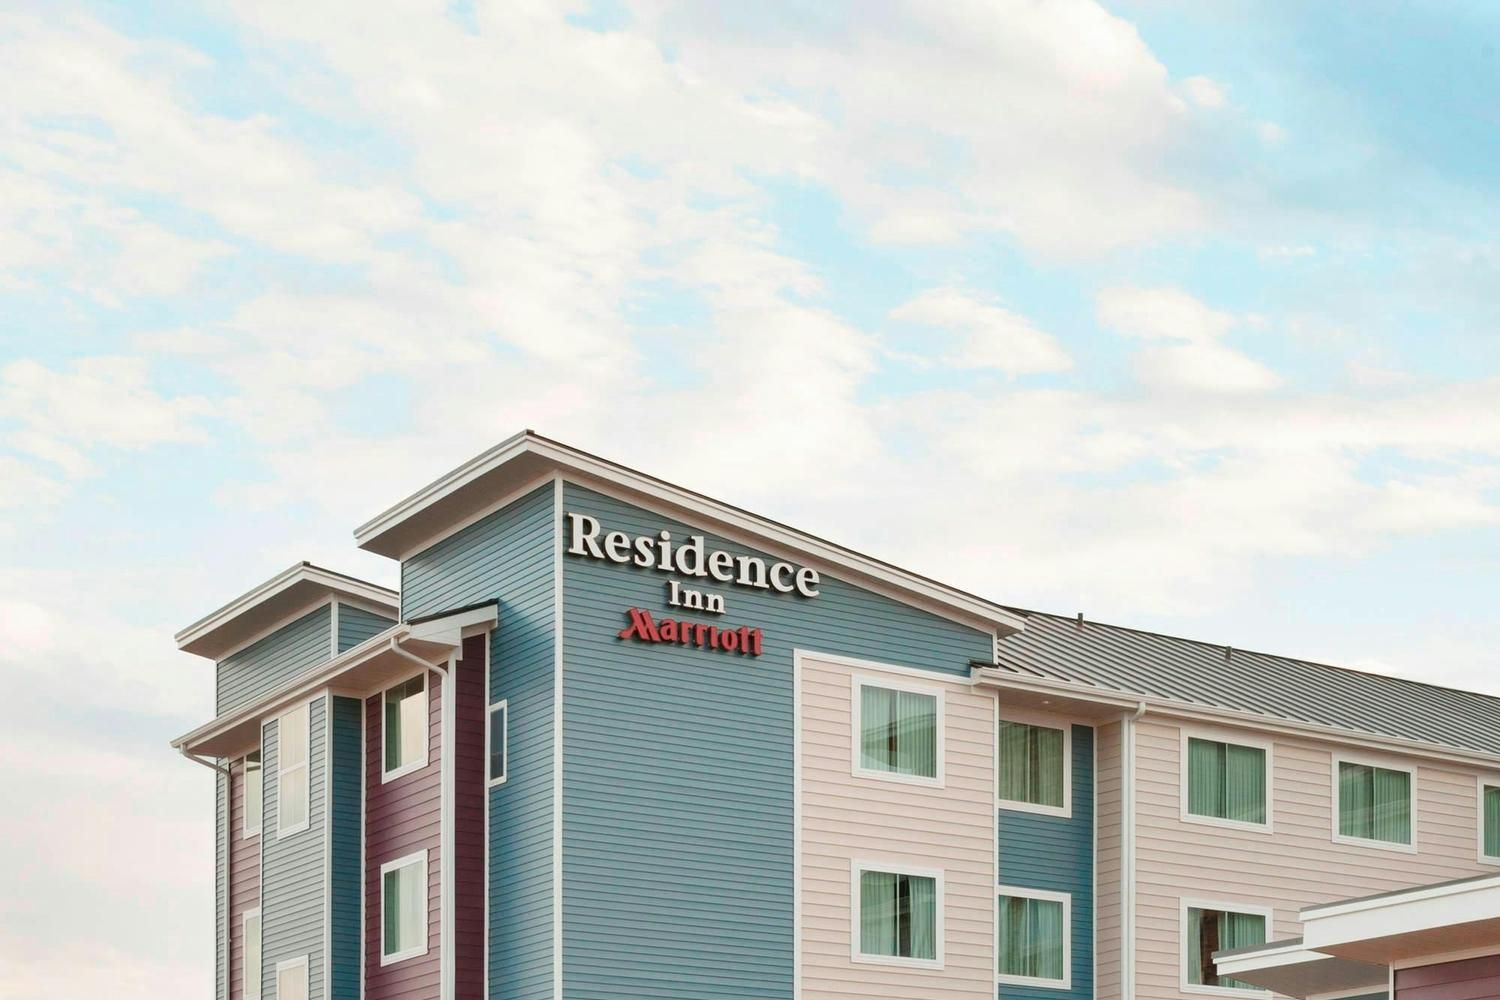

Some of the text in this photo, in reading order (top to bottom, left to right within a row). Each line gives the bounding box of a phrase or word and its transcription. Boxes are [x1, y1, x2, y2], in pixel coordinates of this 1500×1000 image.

[567, 512, 821, 598] Residence
[667, 580, 726, 614] Inn
[617, 606, 764, 656] Marriott
